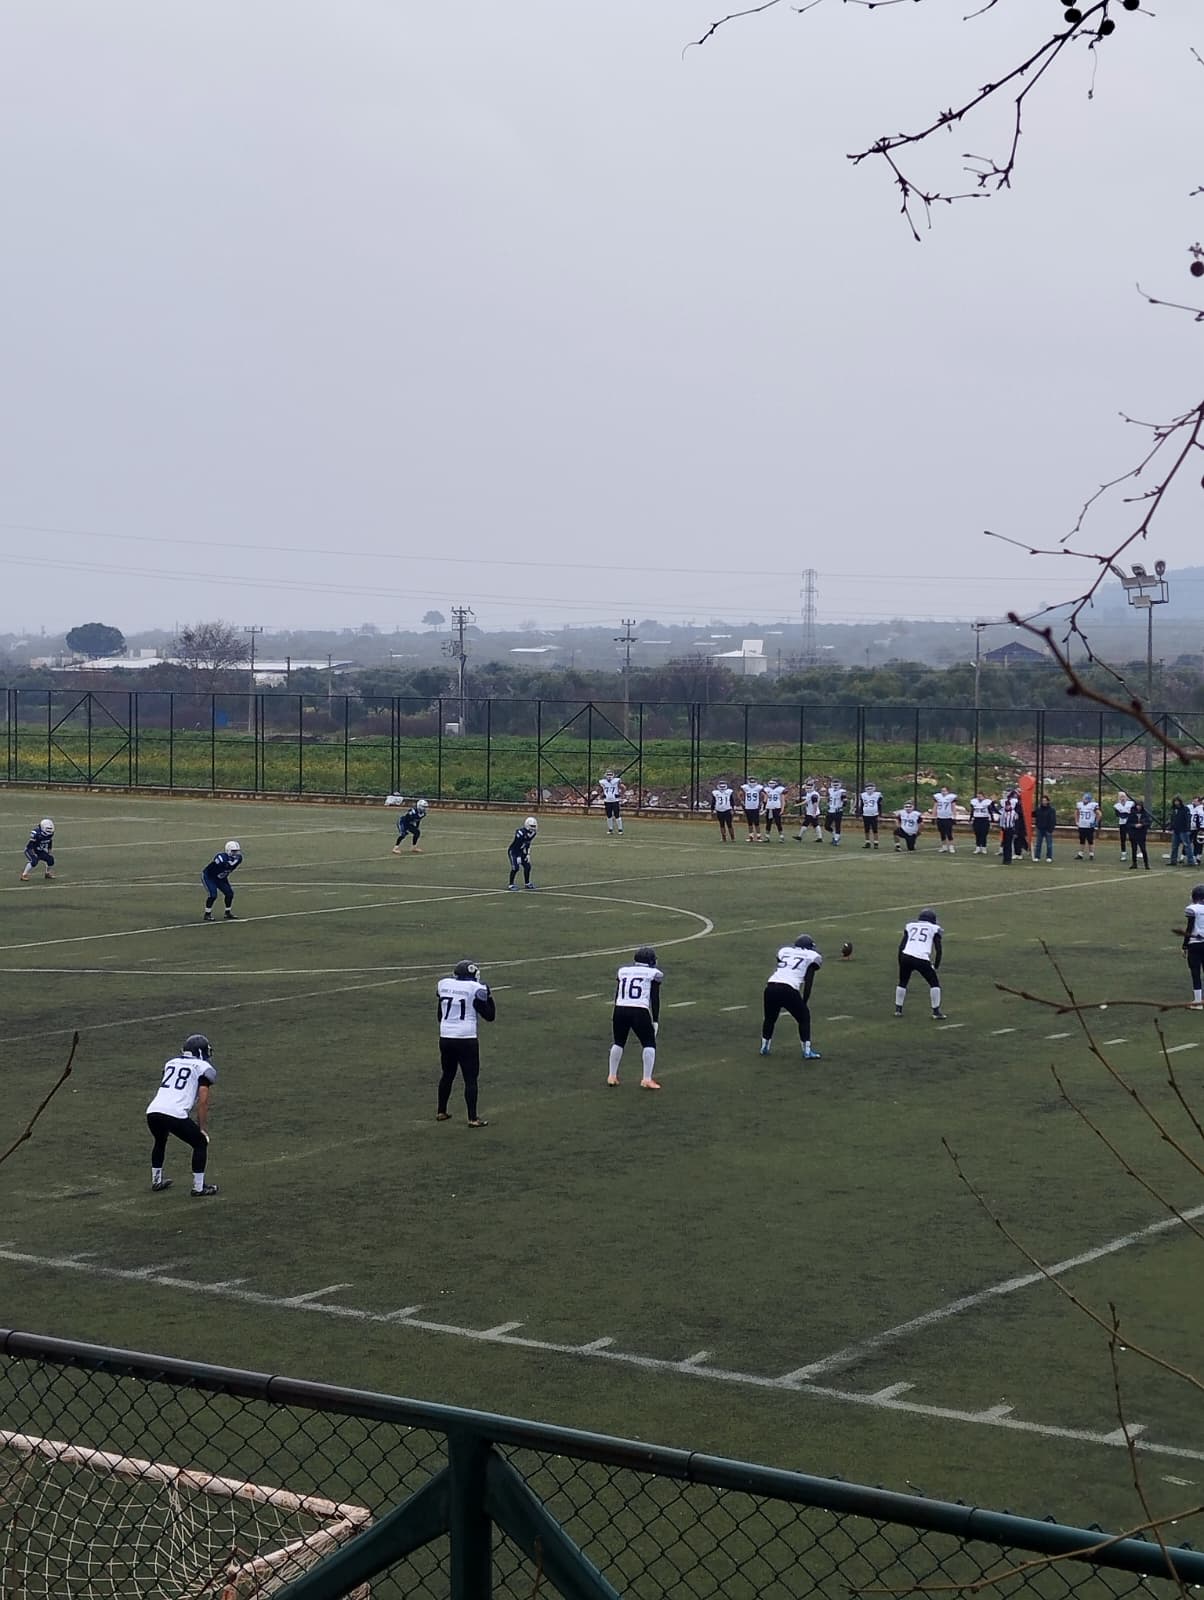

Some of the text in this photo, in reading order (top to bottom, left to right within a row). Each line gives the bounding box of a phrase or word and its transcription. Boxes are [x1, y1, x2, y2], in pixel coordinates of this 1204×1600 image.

[910, 927, 928, 942] 25
[777, 955, 804, 970] 57
[622, 977, 644, 999] 16
[440, 997, 466, 1020] 71
[160, 1066, 192, 1090] 28
